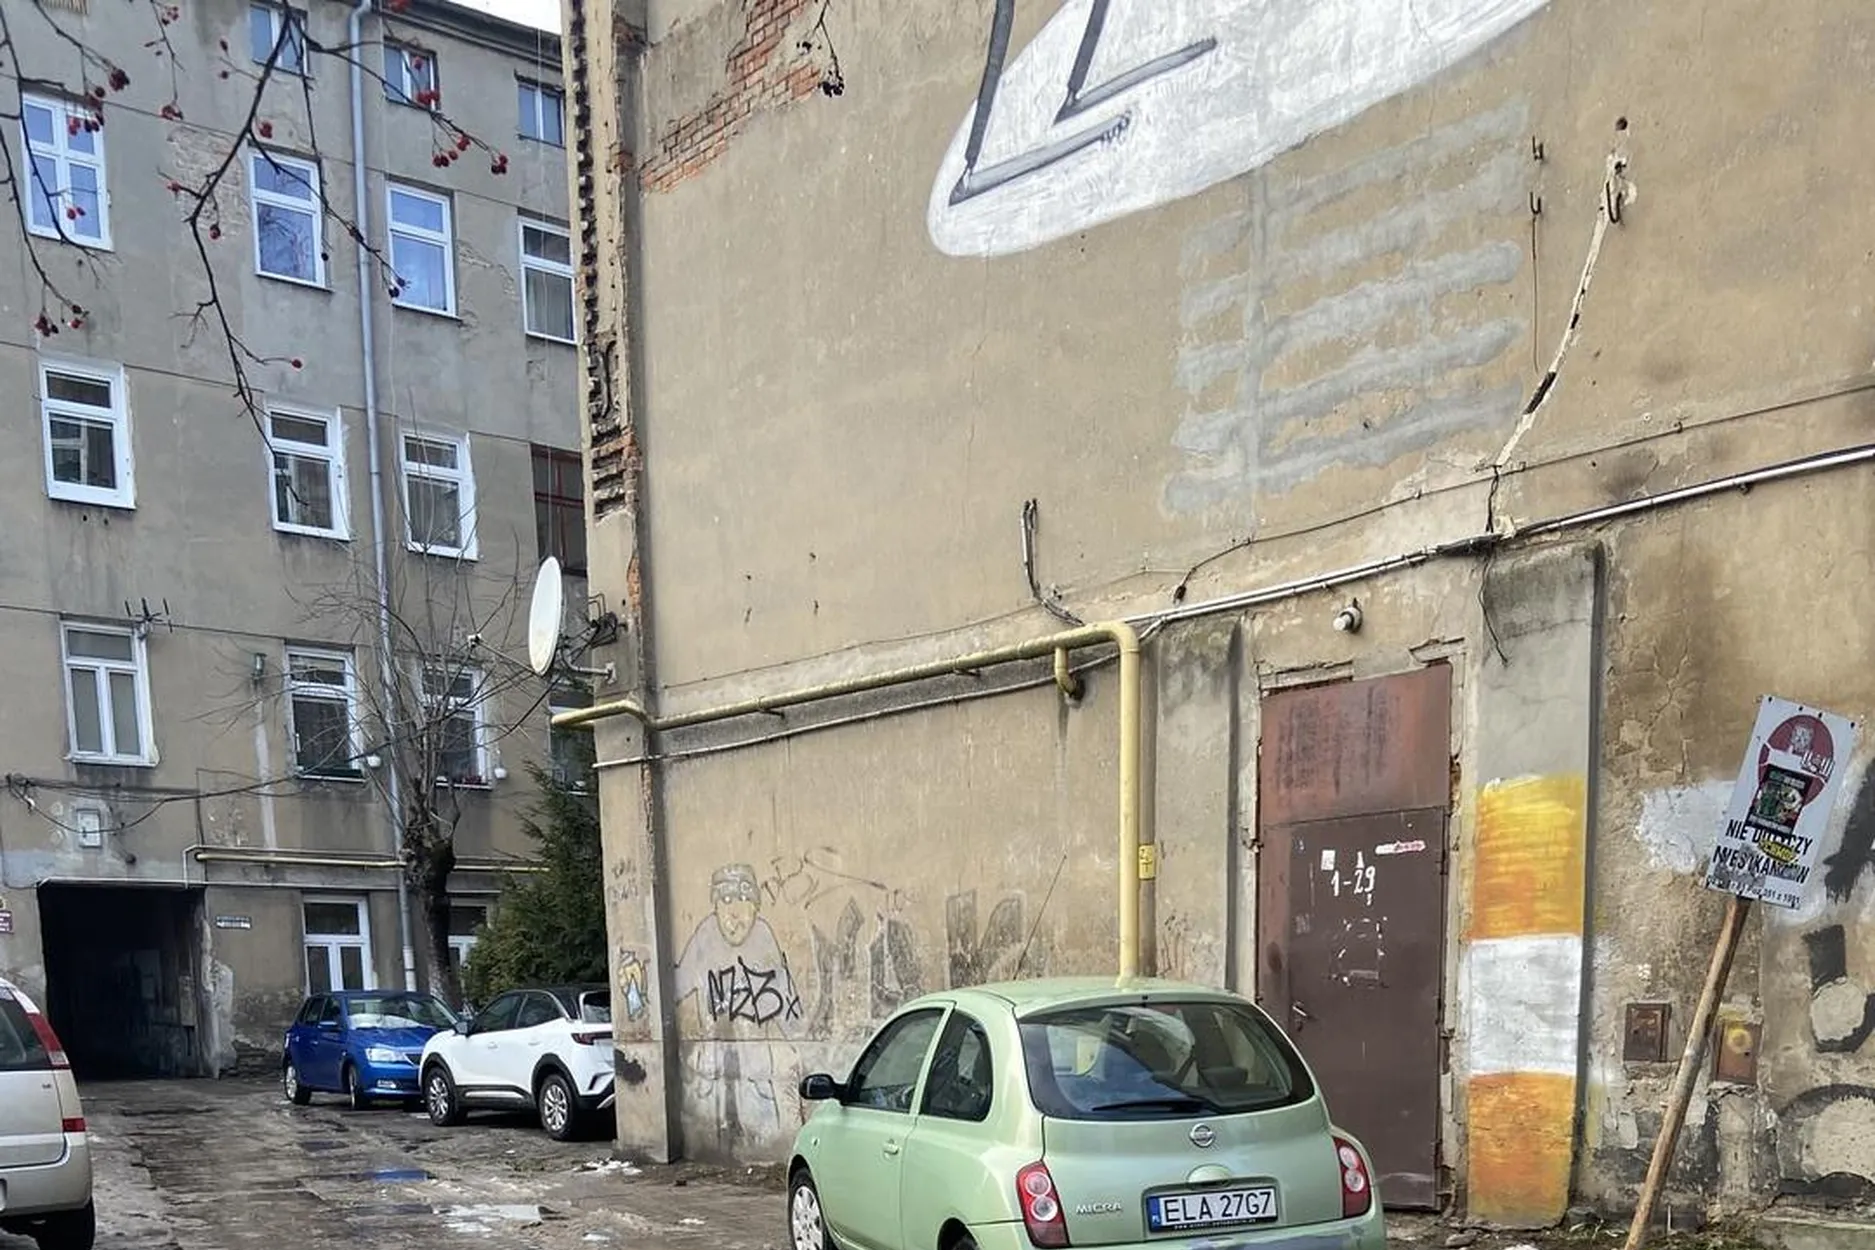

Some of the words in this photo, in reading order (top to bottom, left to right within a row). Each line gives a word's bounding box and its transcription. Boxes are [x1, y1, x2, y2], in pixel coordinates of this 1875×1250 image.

[1725, 819, 1749, 840] NIE
[1331, 865, 1376, 897] 1-29
[1075, 1201, 1122, 1216] MICRA
[1164, 1196, 1214, 1222] ELA
[1219, 1191, 1272, 1218] 27G7
